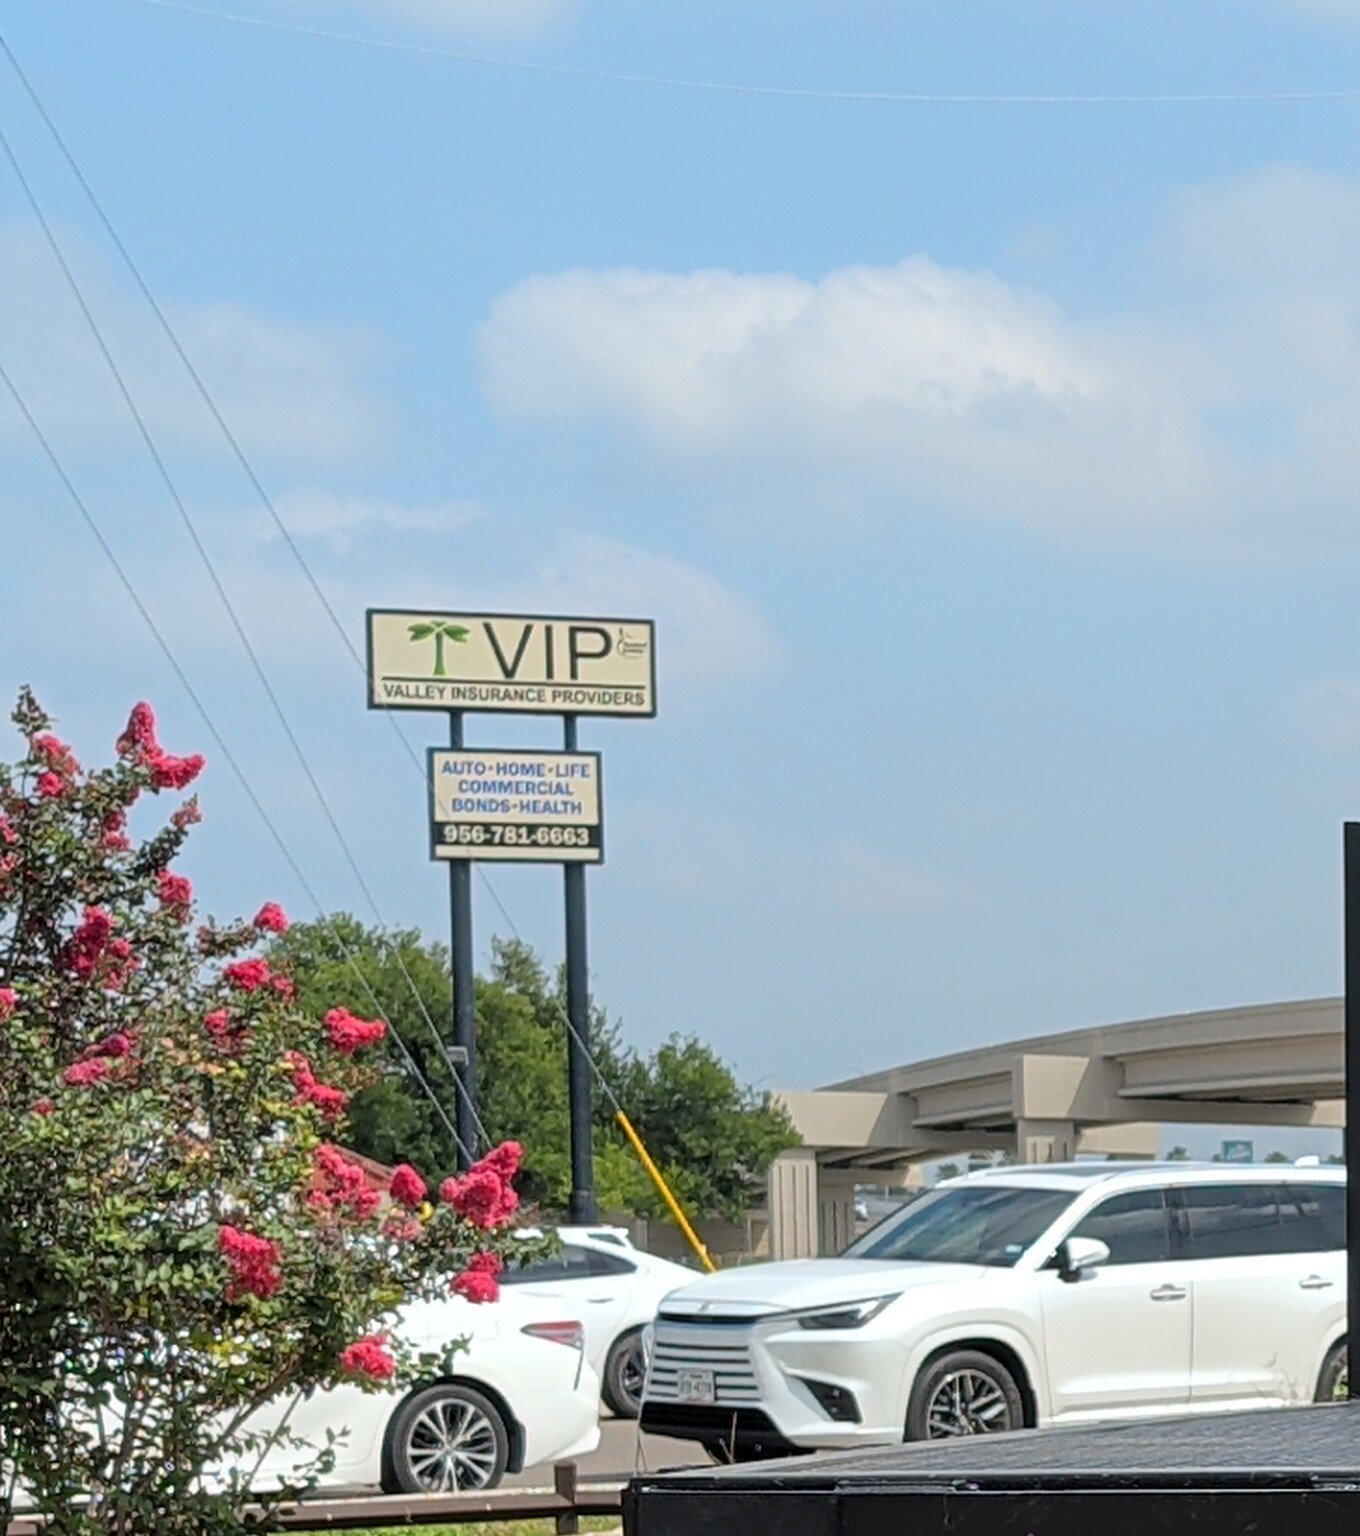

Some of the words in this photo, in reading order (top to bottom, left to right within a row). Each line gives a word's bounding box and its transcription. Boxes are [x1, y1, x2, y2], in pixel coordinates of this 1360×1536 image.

[482, 621, 612, 680] VIP
[383, 683, 446, 700] VALLEY
[450, 688, 546, 703] INSURANCE
[551, 690, 645, 706] PROVIDERS
[458, 779, 574, 796] COMMERCIAL
